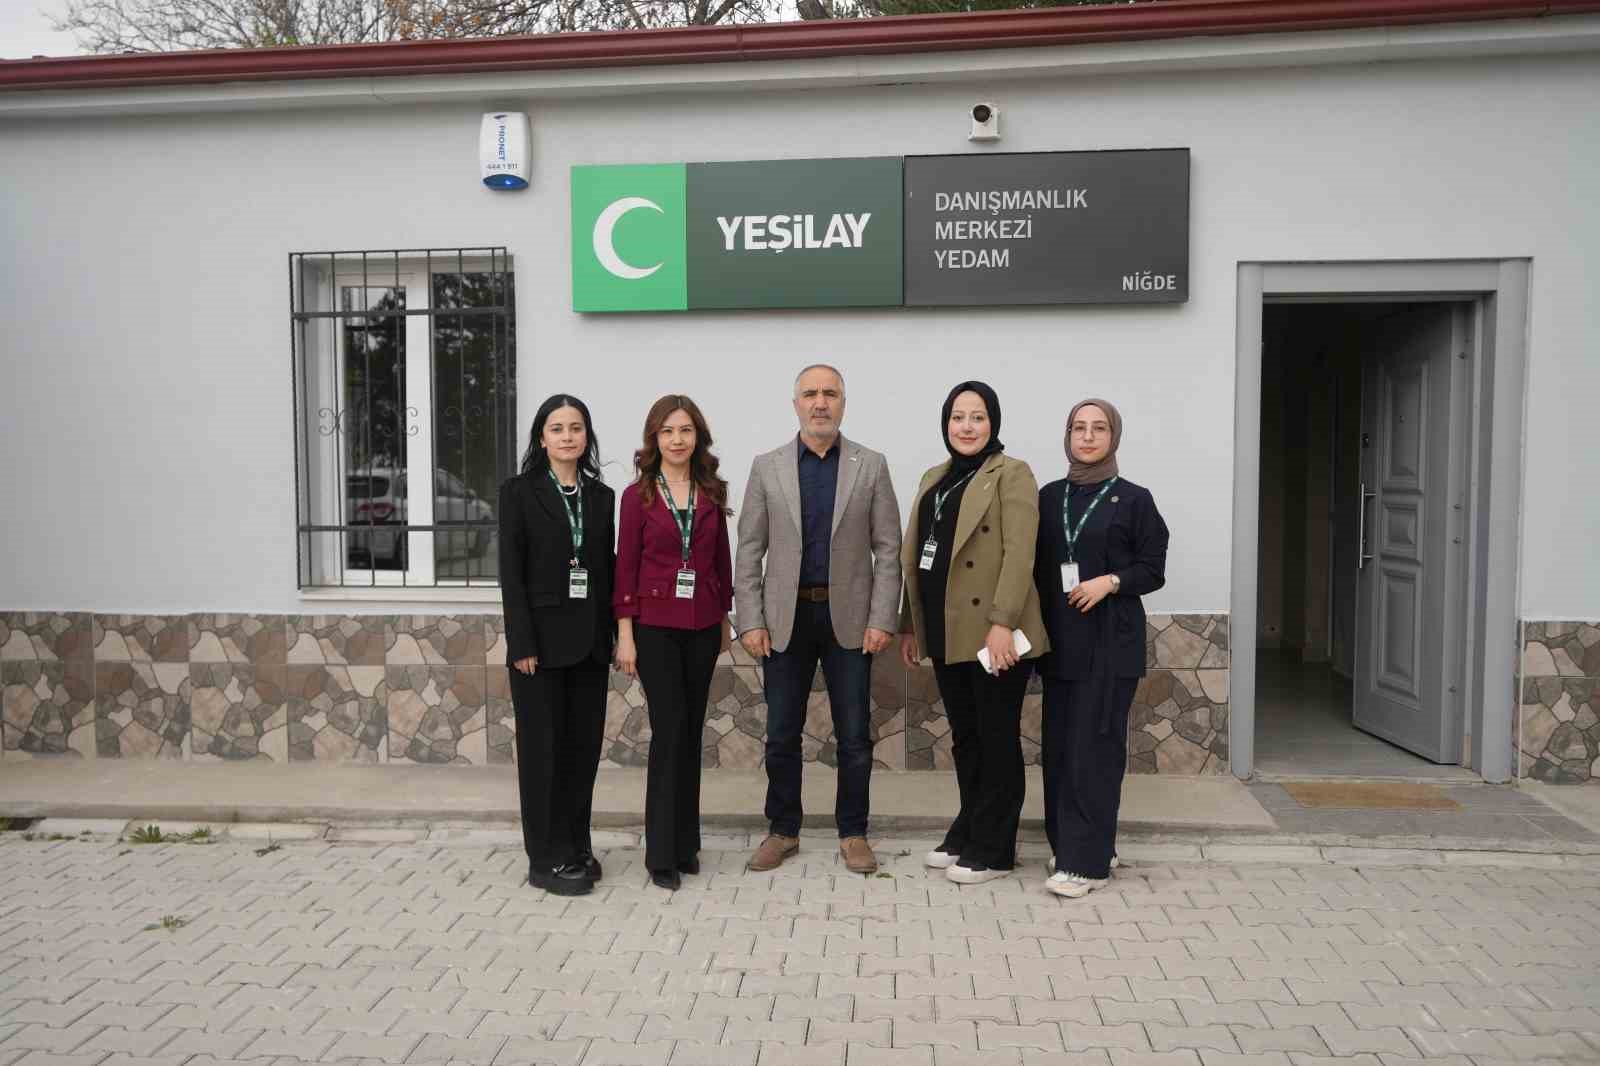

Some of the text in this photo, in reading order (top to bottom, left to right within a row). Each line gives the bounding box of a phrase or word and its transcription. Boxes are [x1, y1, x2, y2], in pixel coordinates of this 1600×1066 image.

[935, 189, 1088, 215] DANIŞMANLIK
[935, 215, 1032, 240] MERKEZİ
[935, 248, 1010, 269] YEDAM
[1122, 271, 1177, 290] NİĞDE
